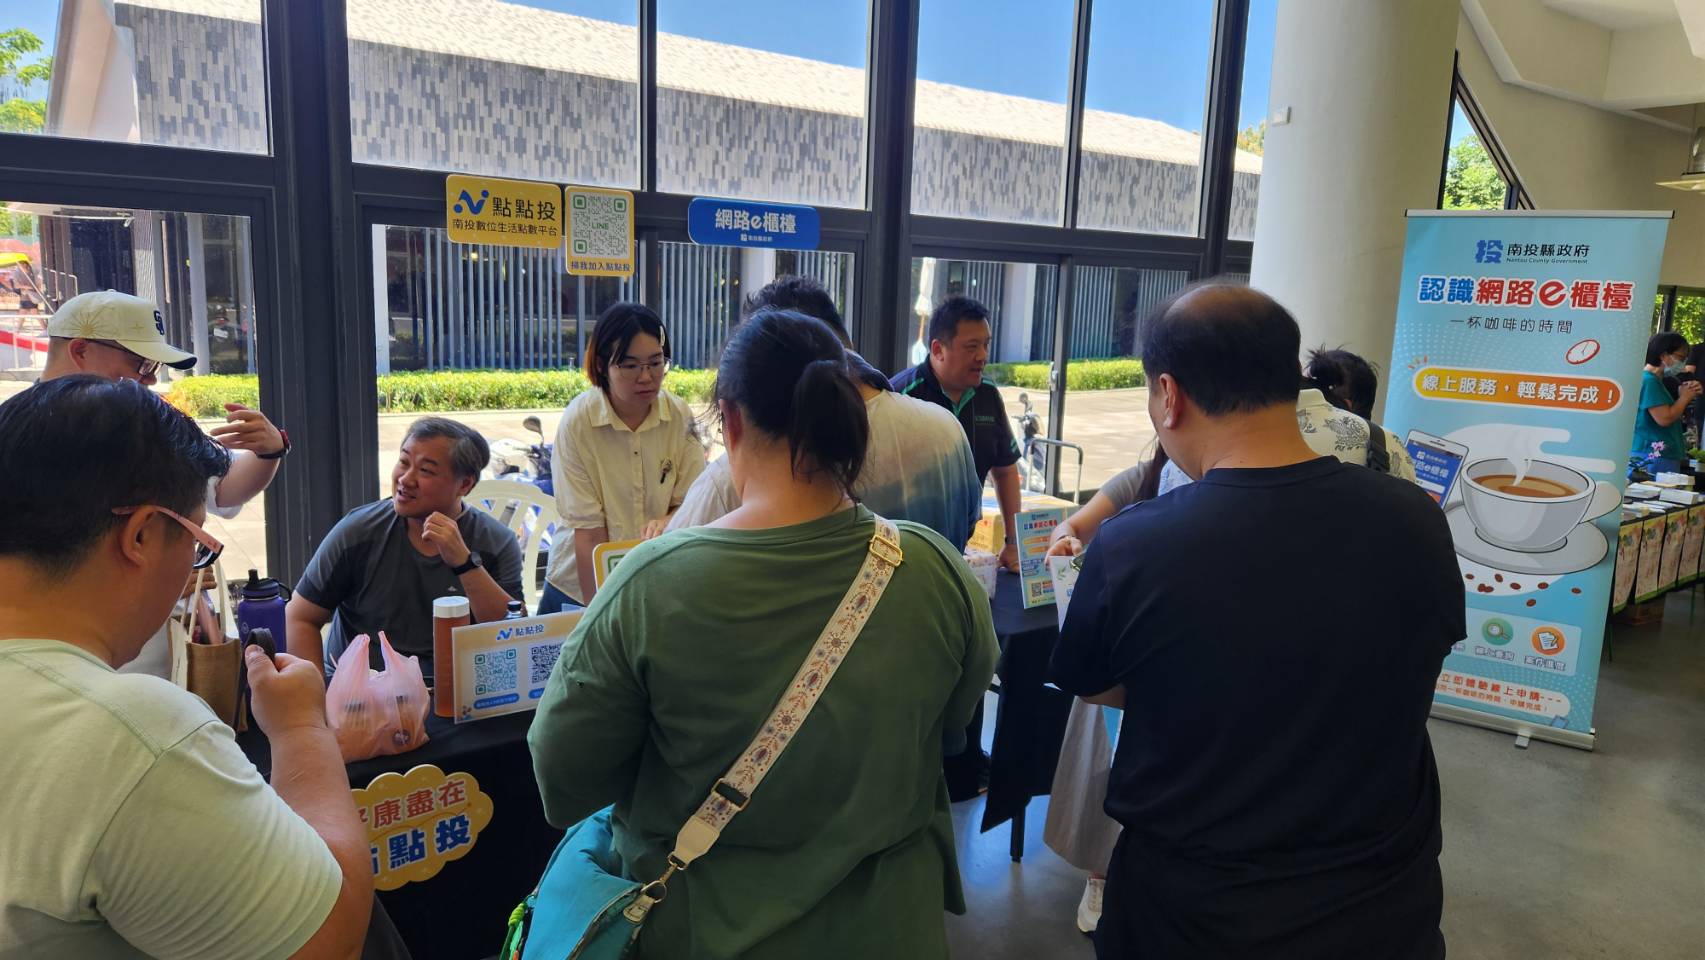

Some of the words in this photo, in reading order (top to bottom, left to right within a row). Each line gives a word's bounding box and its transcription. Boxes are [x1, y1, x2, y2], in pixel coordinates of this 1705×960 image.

[493, 197, 556, 221] 點點投
[452, 219, 557, 236] 南投數位生活點數平台
[592, 222, 609, 230] LINE
[1507, 243, 1591, 257] 南投縣政府
[1450, 316, 1573, 334] 一杯咖啡的時間
[1422, 374, 1613, 404] 線上服務，輕鬆完成！
[515, 624, 545, 637] 點點投
